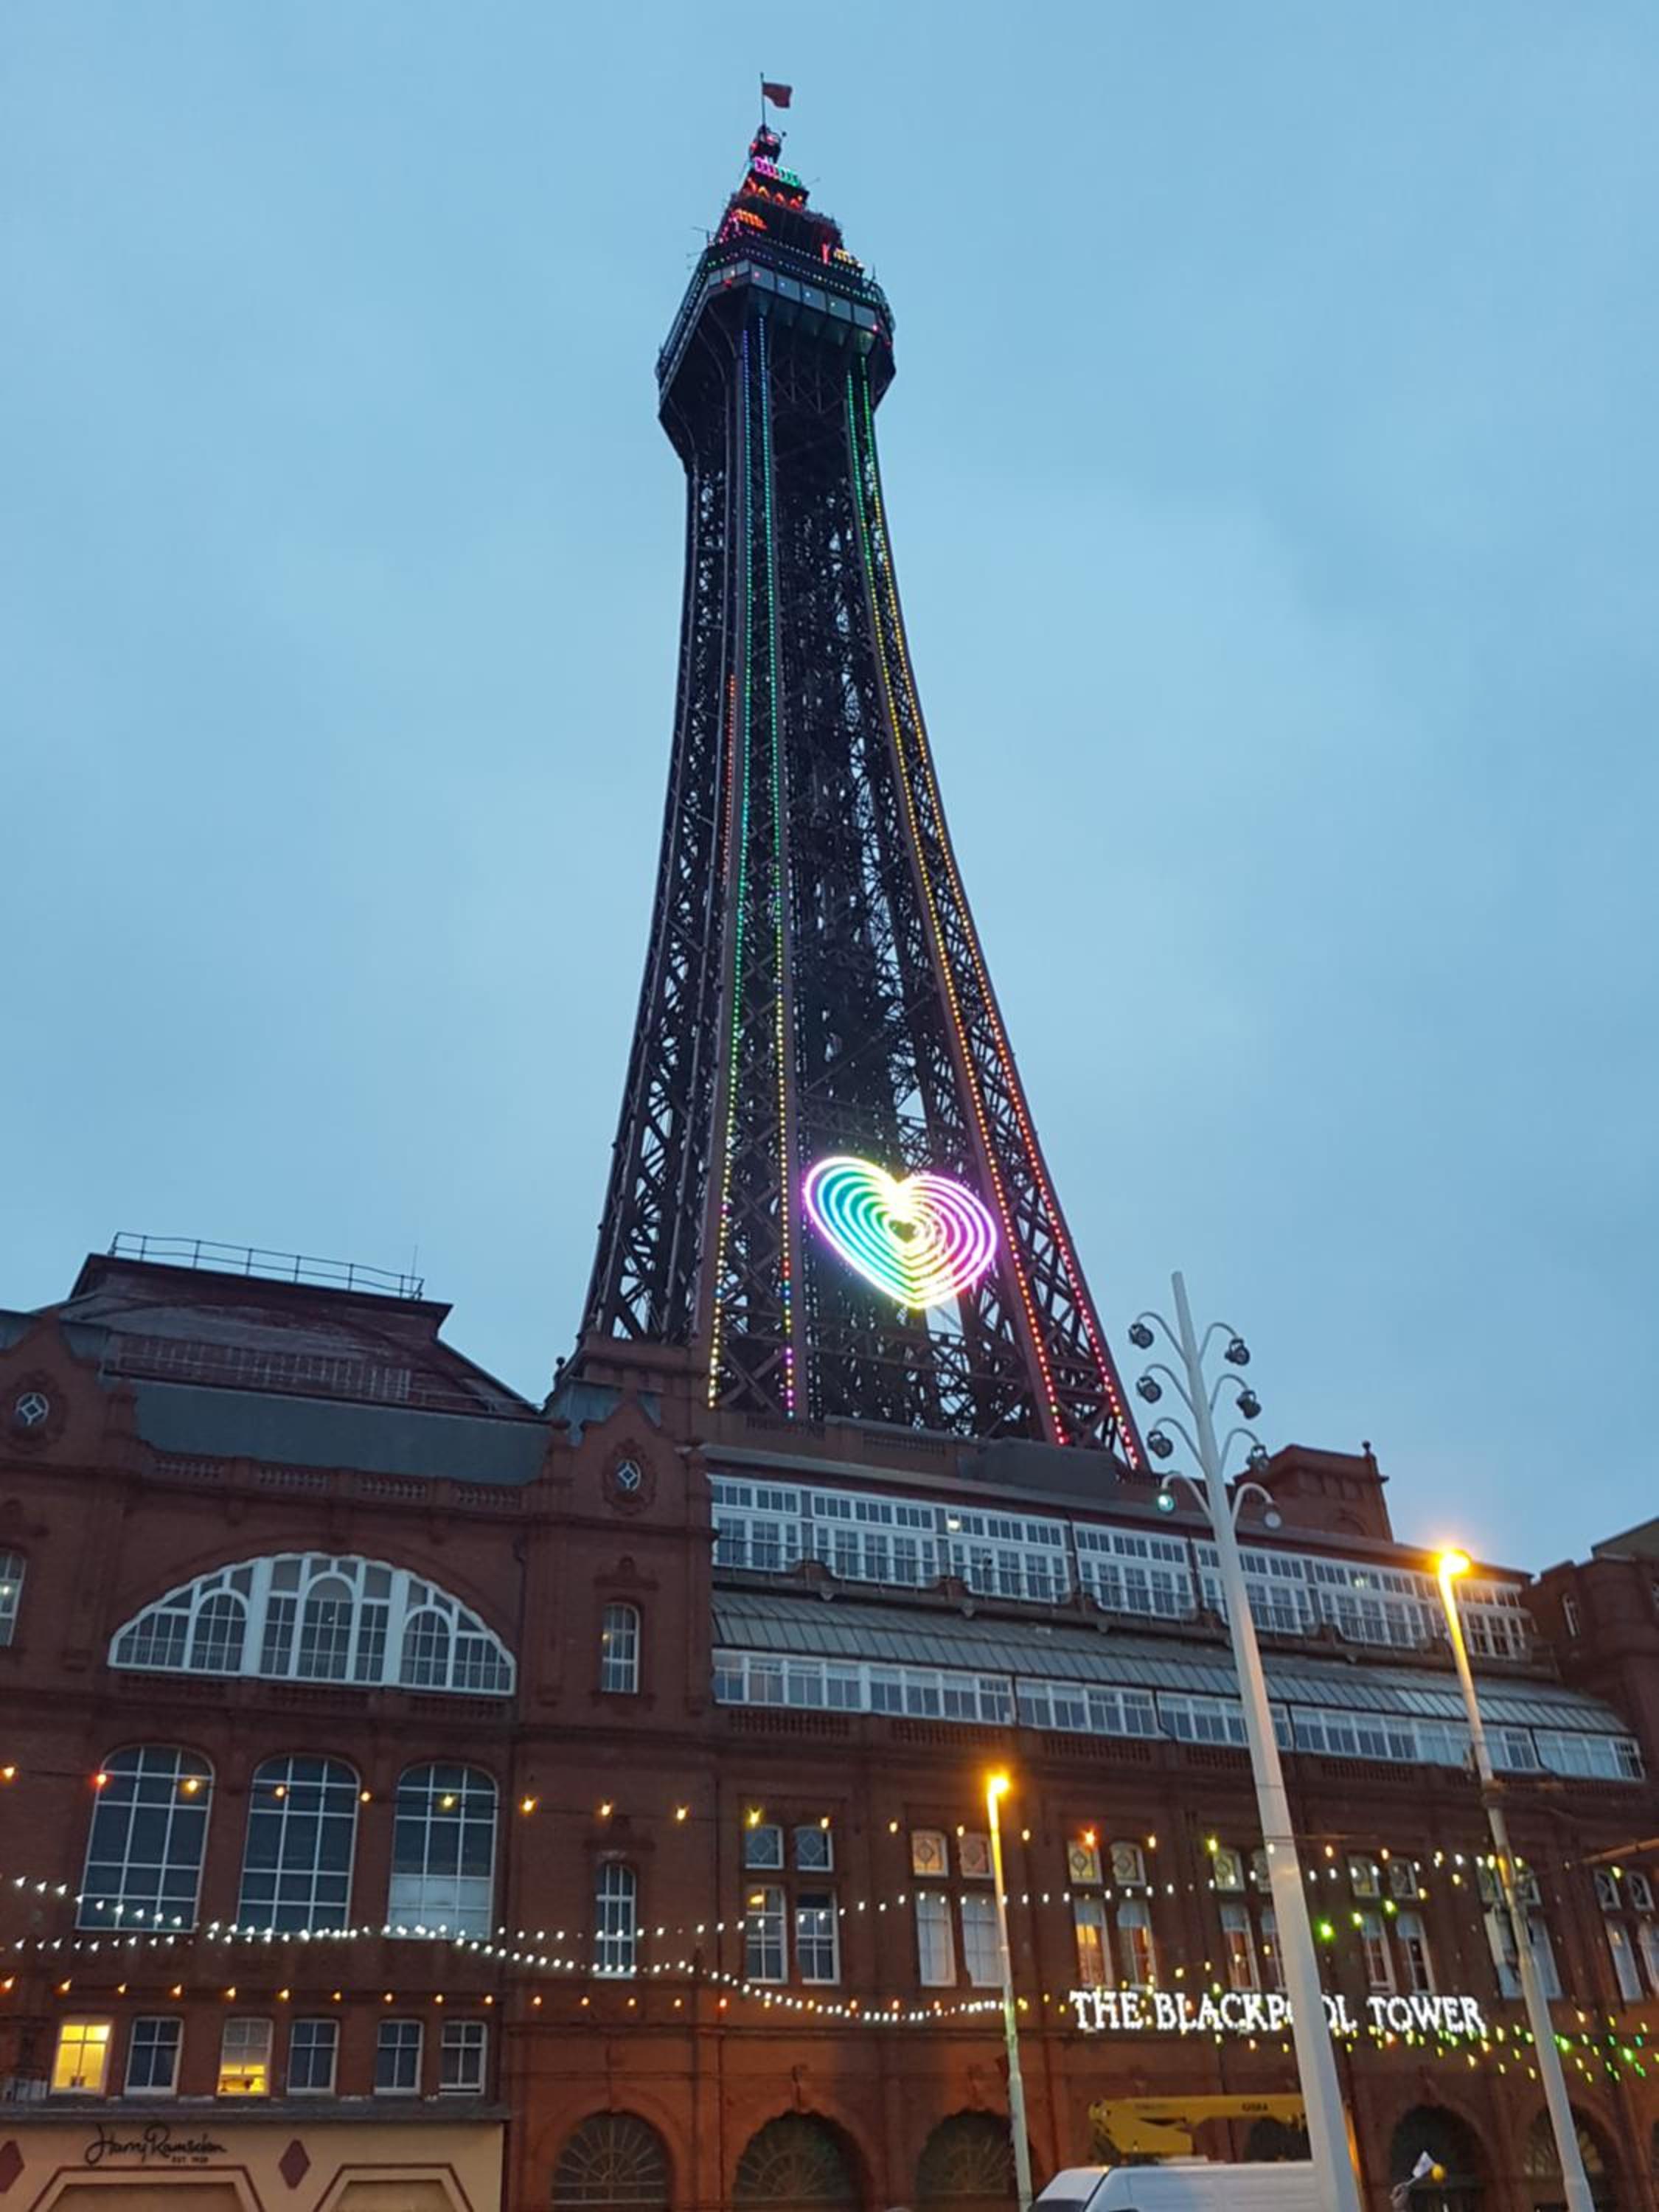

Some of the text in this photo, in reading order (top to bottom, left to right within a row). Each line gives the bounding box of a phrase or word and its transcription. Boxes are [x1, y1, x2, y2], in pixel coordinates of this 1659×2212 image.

[1070, 1990, 1144, 2029] THE
[1367, 1995, 1487, 2038] TOWER
[85, 2123, 147, 2165] Harry
